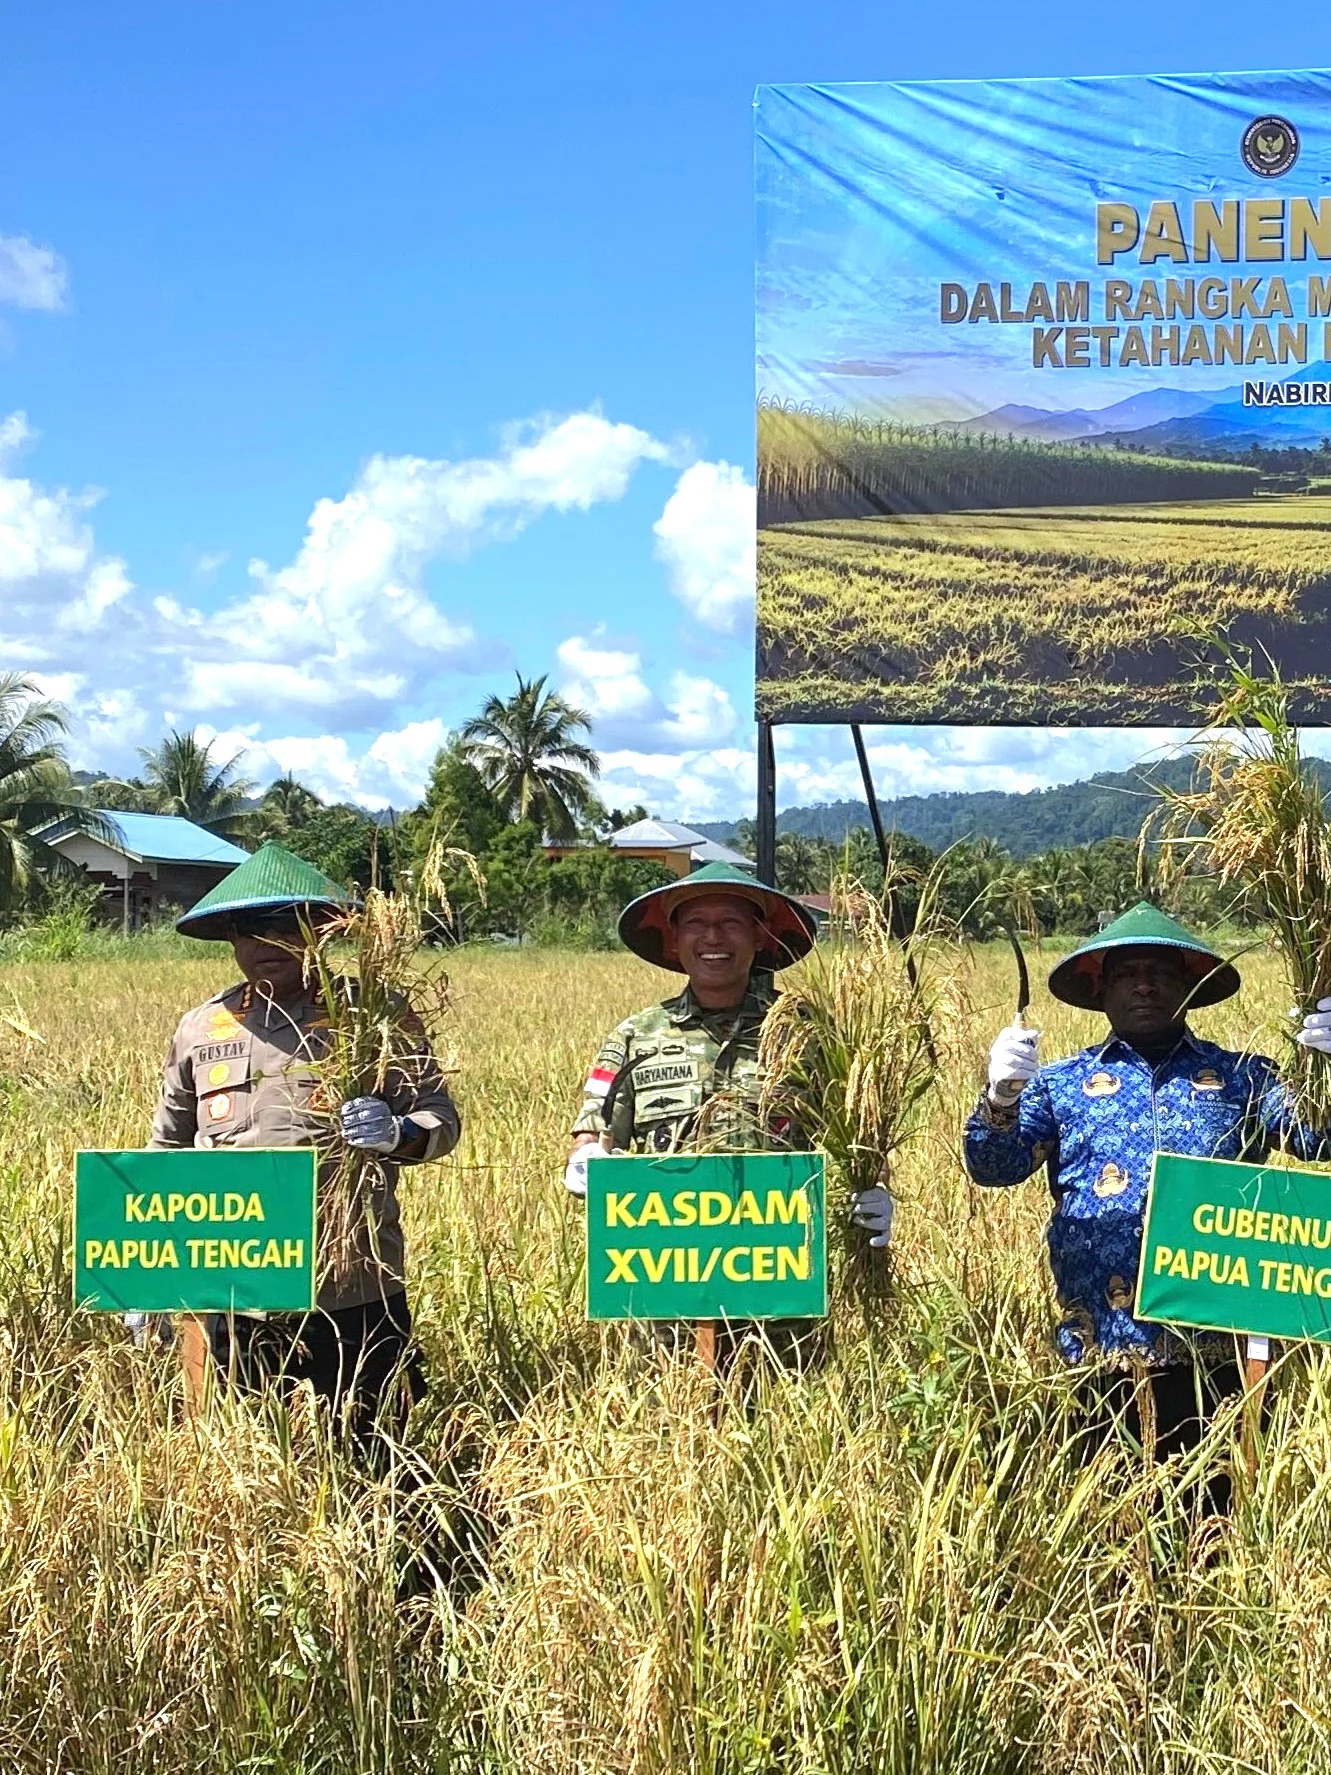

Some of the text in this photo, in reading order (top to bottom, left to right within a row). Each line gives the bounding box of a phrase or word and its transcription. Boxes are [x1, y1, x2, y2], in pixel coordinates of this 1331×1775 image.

[940, 280, 1090, 324] DALAM
[1105, 276, 1293, 321] RANGKA
[1032, 322, 1308, 368] KETAHANAN
[199, 1041, 246, 1062] GUSTAV
[125, 1193, 265, 1222] KAPOLDA
[605, 1190, 808, 1227] KASDAM
[85, 1239, 304, 1268] PAPUA TENGAH
[605, 1246, 808, 1283] XVII/CEN
[1154, 1245, 1250, 1287] PAPUA
